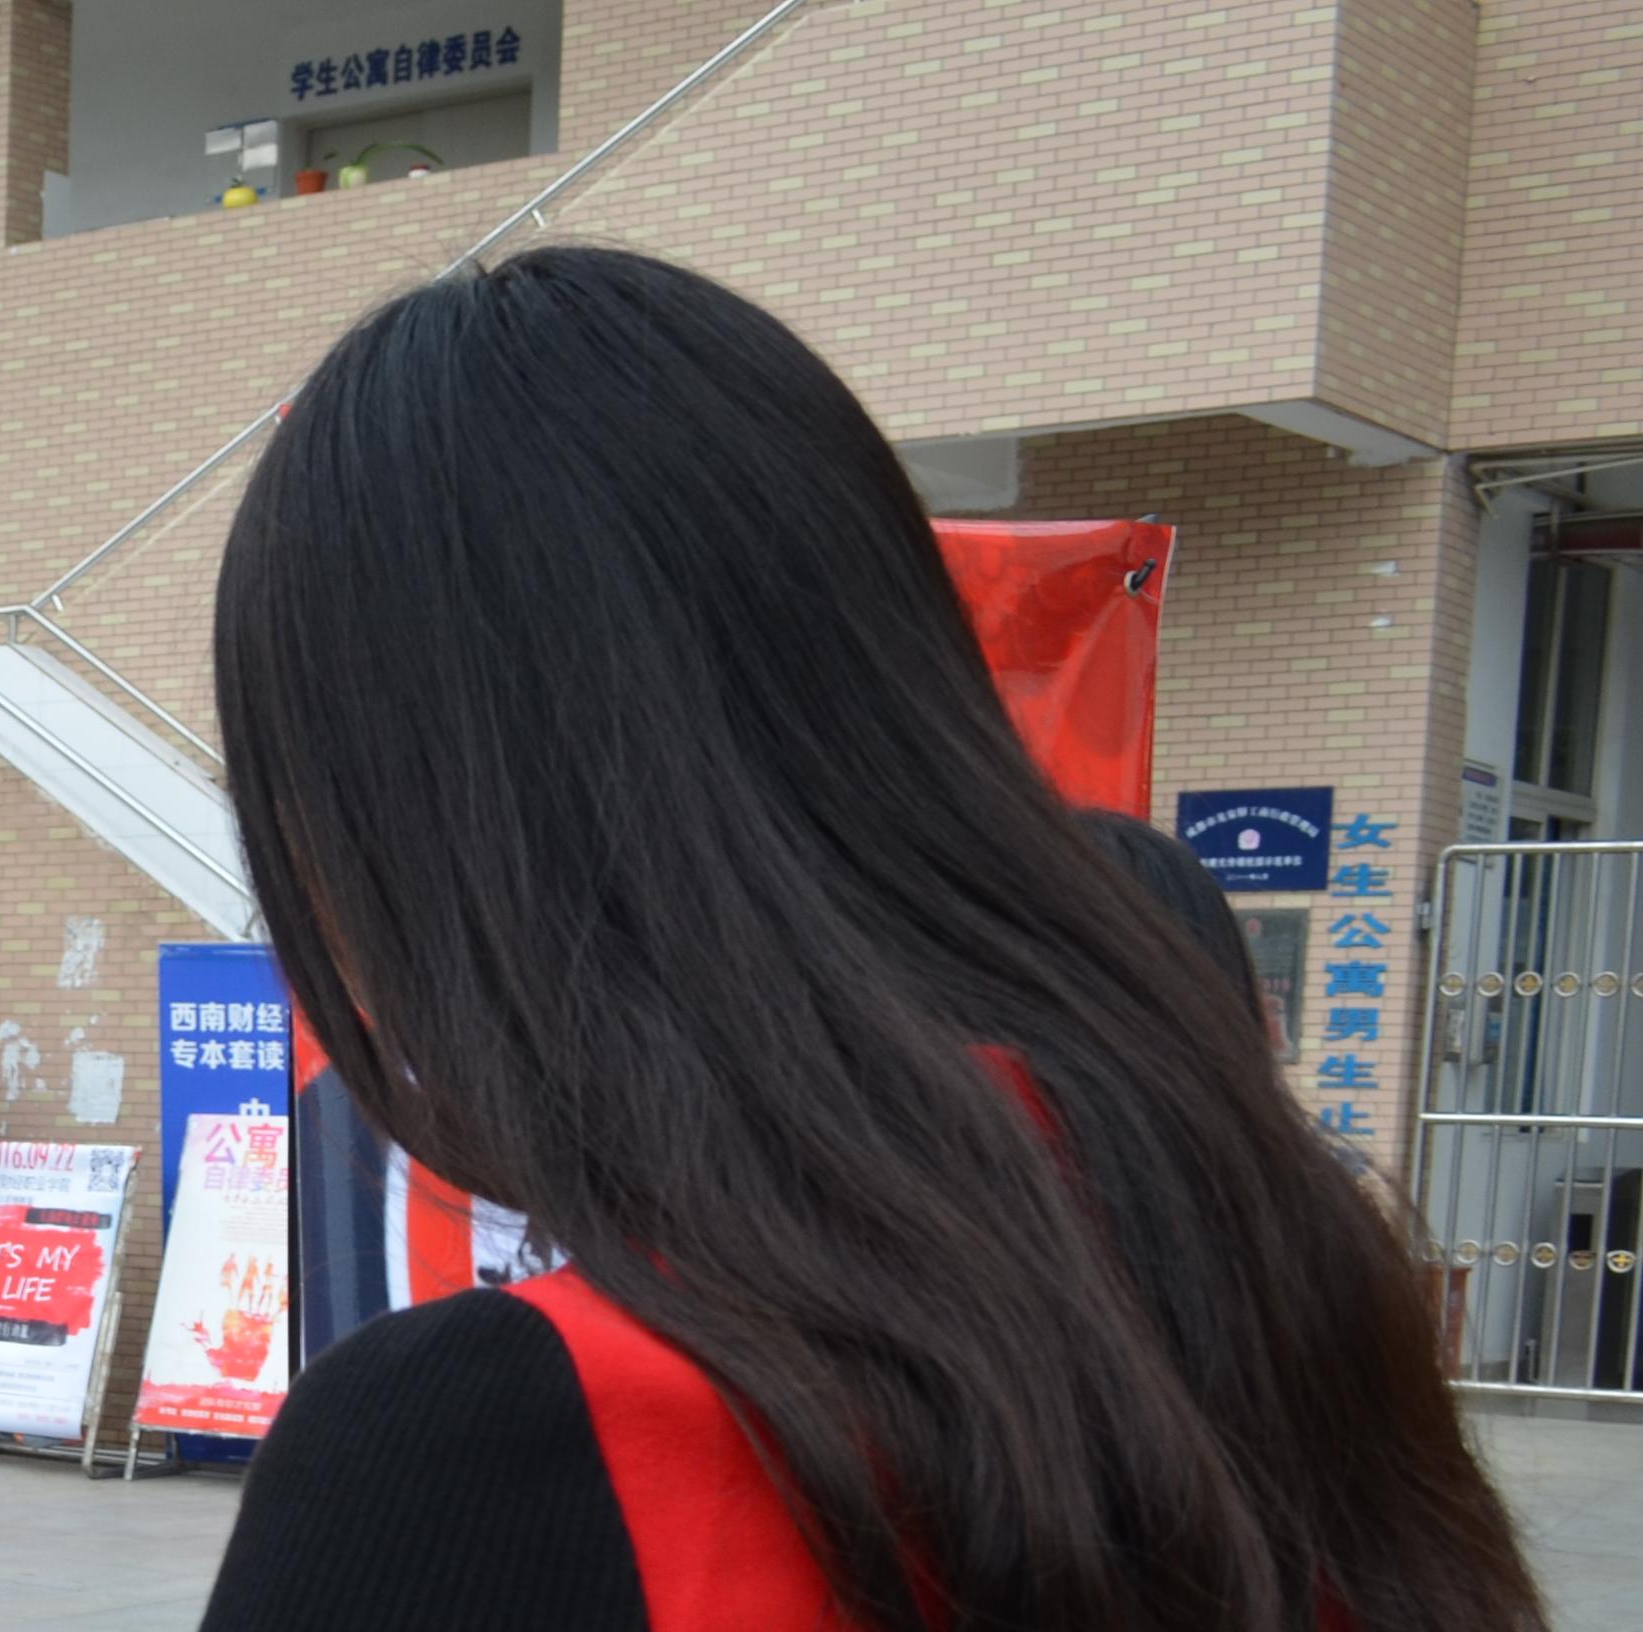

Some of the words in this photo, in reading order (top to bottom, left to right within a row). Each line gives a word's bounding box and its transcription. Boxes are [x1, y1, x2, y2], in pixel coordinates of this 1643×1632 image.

[290, 26, 521, 101] 学生公寓自律委员会
[169, 1001, 290, 1033] 西南财经
[169, 1039, 285, 1071] 专本套读
[203, 1122, 284, 1169] 公寓
[35, 1243, 82, 1272] MY
[1, 1275, 57, 1302] LIFE
